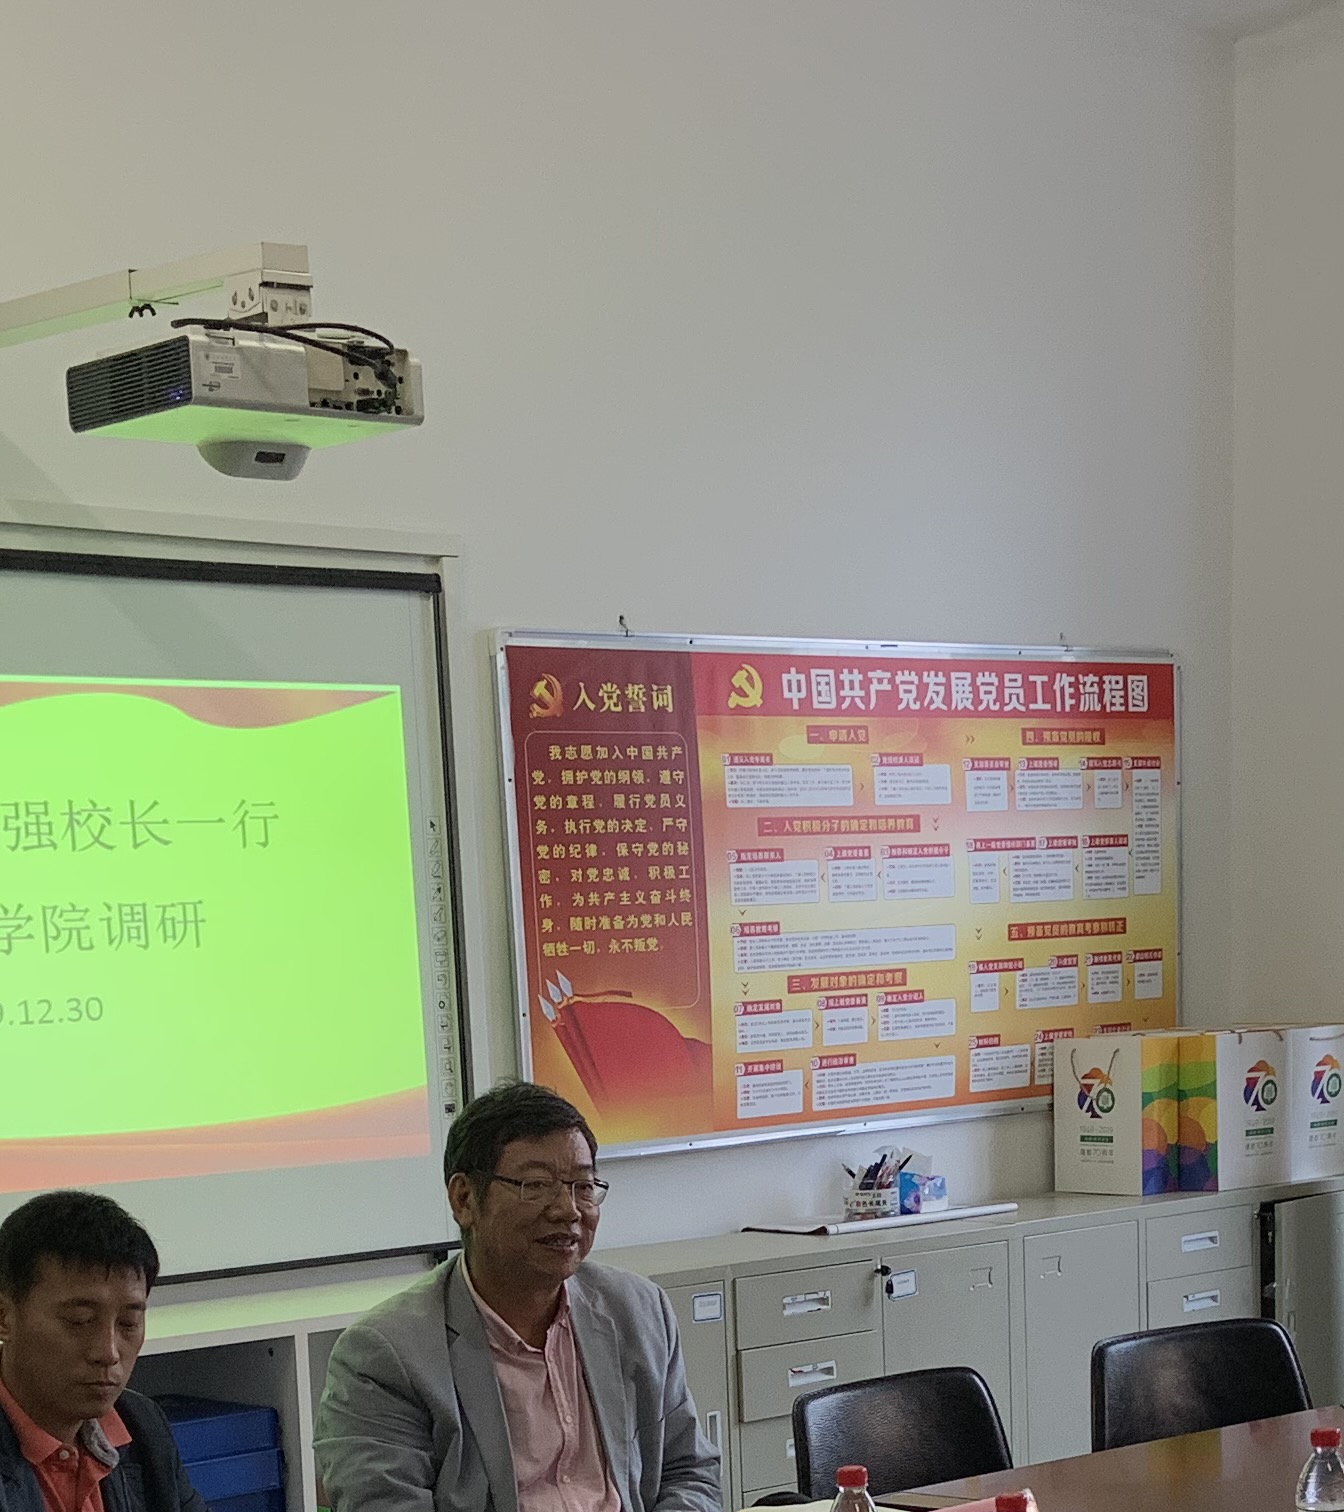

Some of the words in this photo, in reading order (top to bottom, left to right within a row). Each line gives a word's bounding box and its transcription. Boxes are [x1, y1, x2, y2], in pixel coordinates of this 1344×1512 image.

[572, 681, 675, 714] 入党誓词
[781, 666, 1149, 713] 中国共产党发展党员工作流程图
[548, 744, 684, 761] 我志愿加入中国共产
